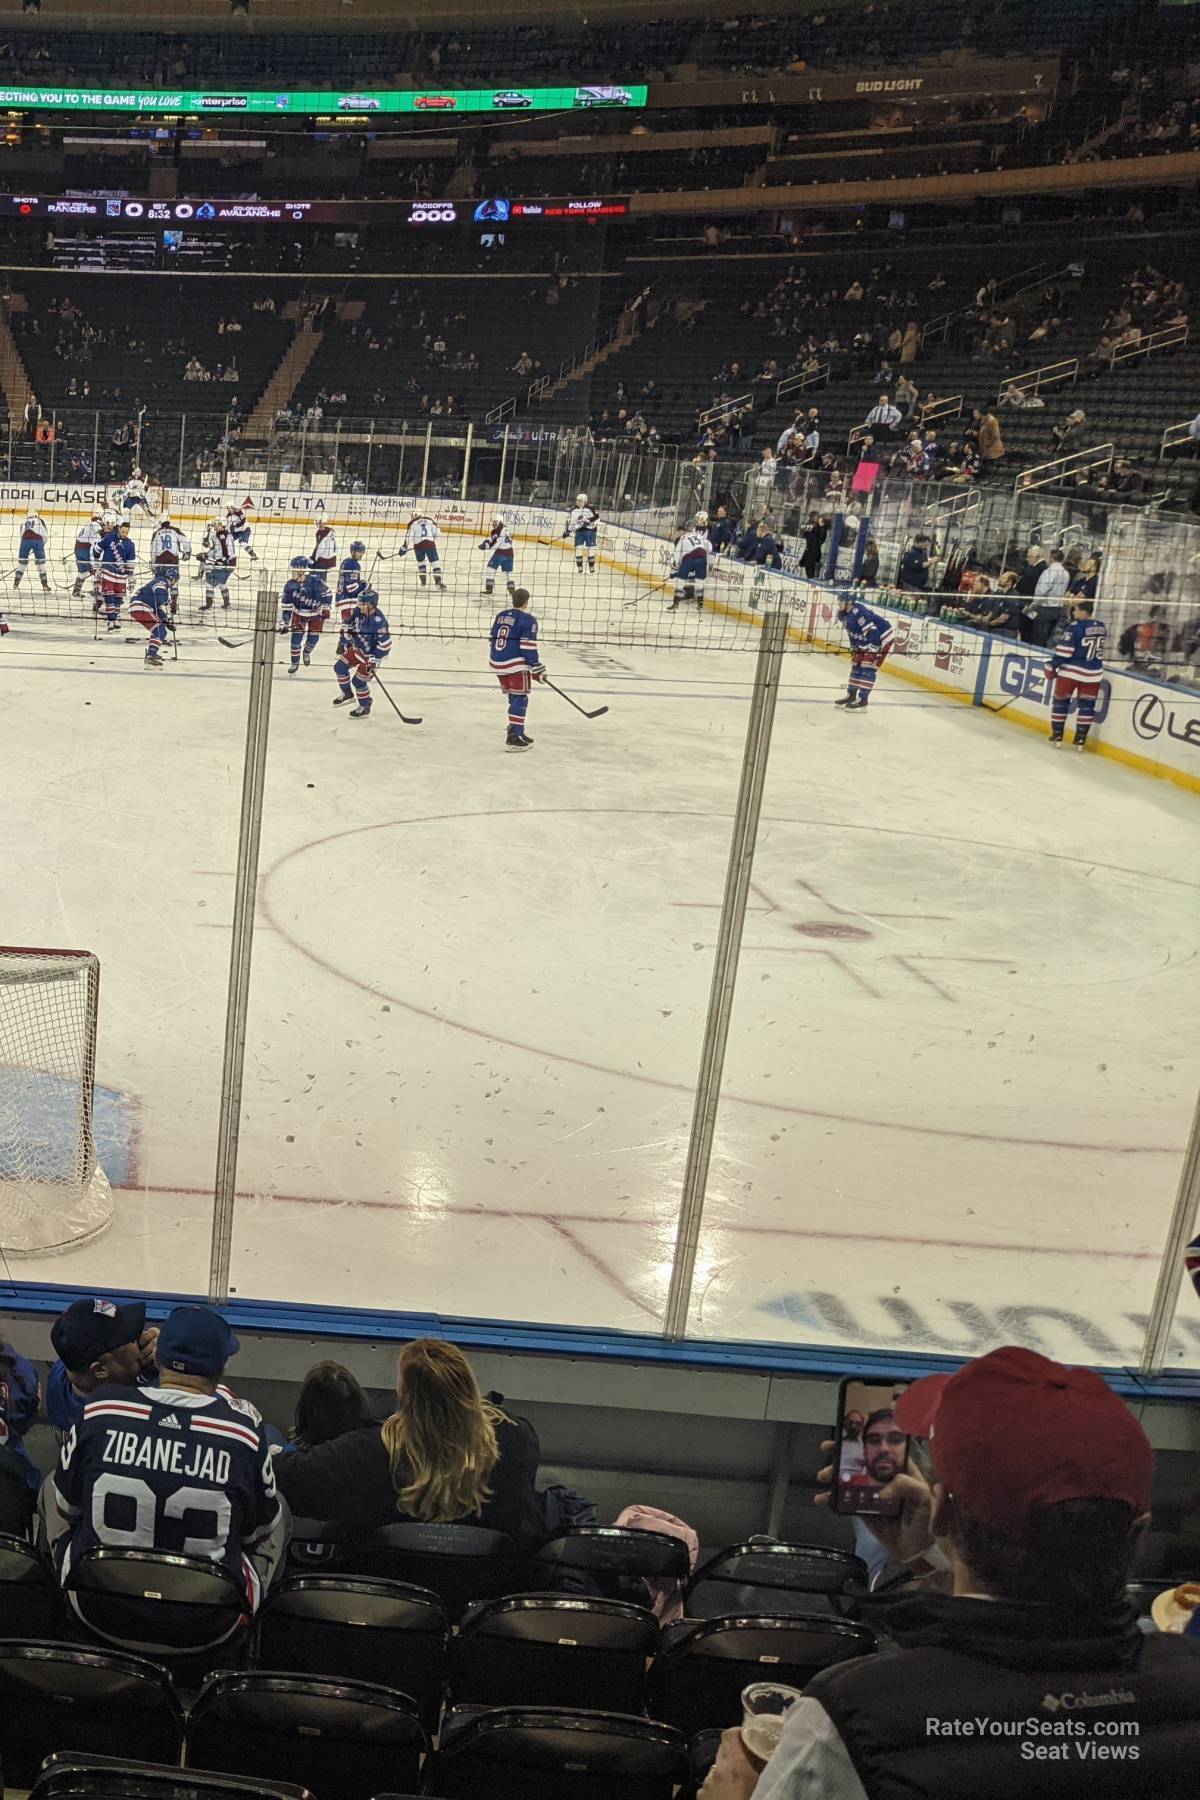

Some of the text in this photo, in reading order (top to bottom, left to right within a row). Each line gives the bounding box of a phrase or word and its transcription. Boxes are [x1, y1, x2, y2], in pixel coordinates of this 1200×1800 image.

[856, 77, 923, 93] BUD LIGHT
[39, 93, 62, 103] YOU
[64, 94, 79, 104] TO
[81, 95, 103, 105] THE
[104, 95, 135, 105] GAME
[158, 96, 182, 106] LOVE
[192, 96, 247, 107] enterprise
[20, 204, 31, 214] 0
[48, 205, 97, 214] RANGERS
[125, 203, 143, 217] 0
[148, 210, 170, 219] 8:32
[175, 204, 193, 218] 0
[293, 211, 302, 219] 0
[43, 489, 106, 504] CHASE
[171, 495, 221, 506] BETMGM
[262, 496, 326, 511] DELTA
[370, 498, 417, 509] Northwell
[369, 508, 400, 519] Health
[495, 625, 510, 651] 8
[158, 1420, 182, 1430] adidas
[102, 1429, 231, 1484] ZIBANEJAD
[1059, 1688, 1137, 1709] Columbia
